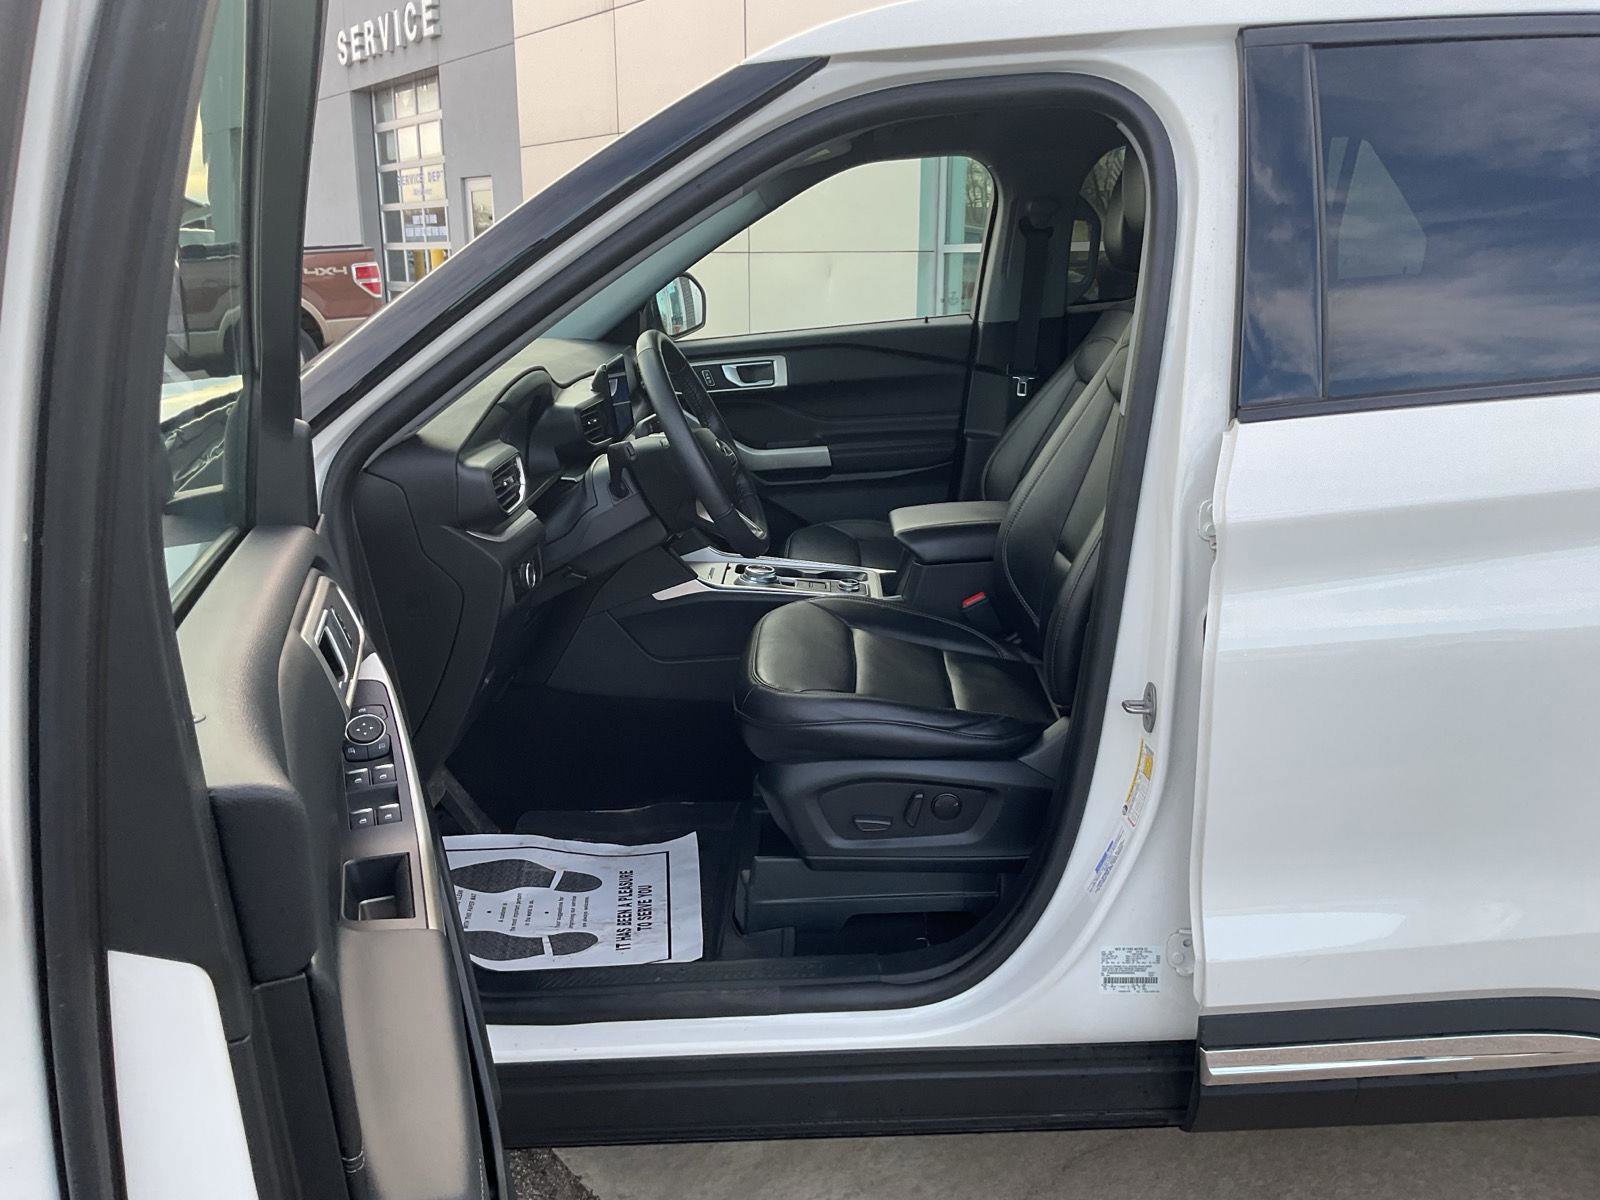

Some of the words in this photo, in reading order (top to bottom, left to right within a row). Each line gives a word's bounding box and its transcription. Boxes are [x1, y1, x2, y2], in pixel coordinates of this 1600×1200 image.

[337, 0, 434, 65] SERVICE
[617, 870, 634, 902] PLEASURE
[637, 884, 653, 898] YOU
[616, 909, 632, 926] BEEN
[637, 899, 653, 921] SERVE
[616, 927, 632, 942] HAS
[637, 922, 652, 931] TO
[616, 943, 631, 951] IT
